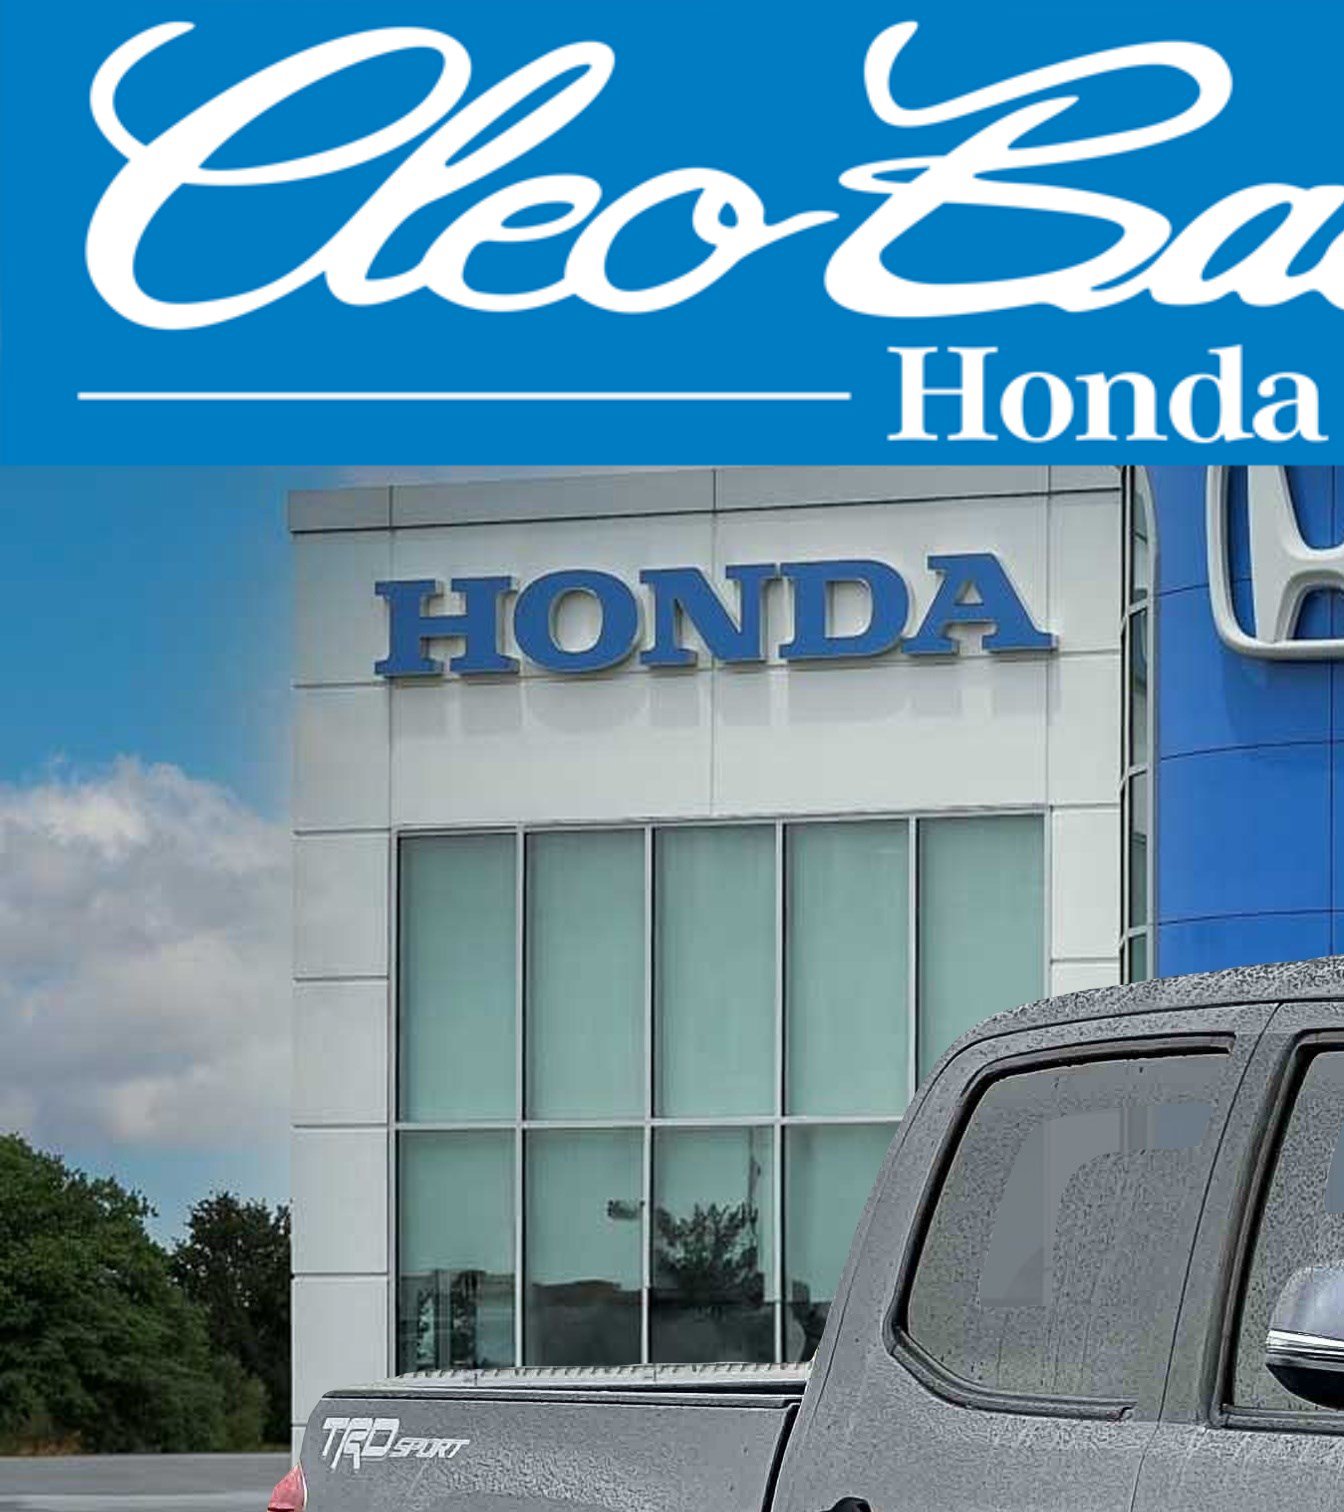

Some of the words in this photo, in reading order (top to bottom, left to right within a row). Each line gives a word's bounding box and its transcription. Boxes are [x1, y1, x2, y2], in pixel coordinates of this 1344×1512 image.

[374, 552, 1058, 677] HONDA
[322, 1417, 400, 1471] TRD
[393, 1437, 470, 1458] SPORT
